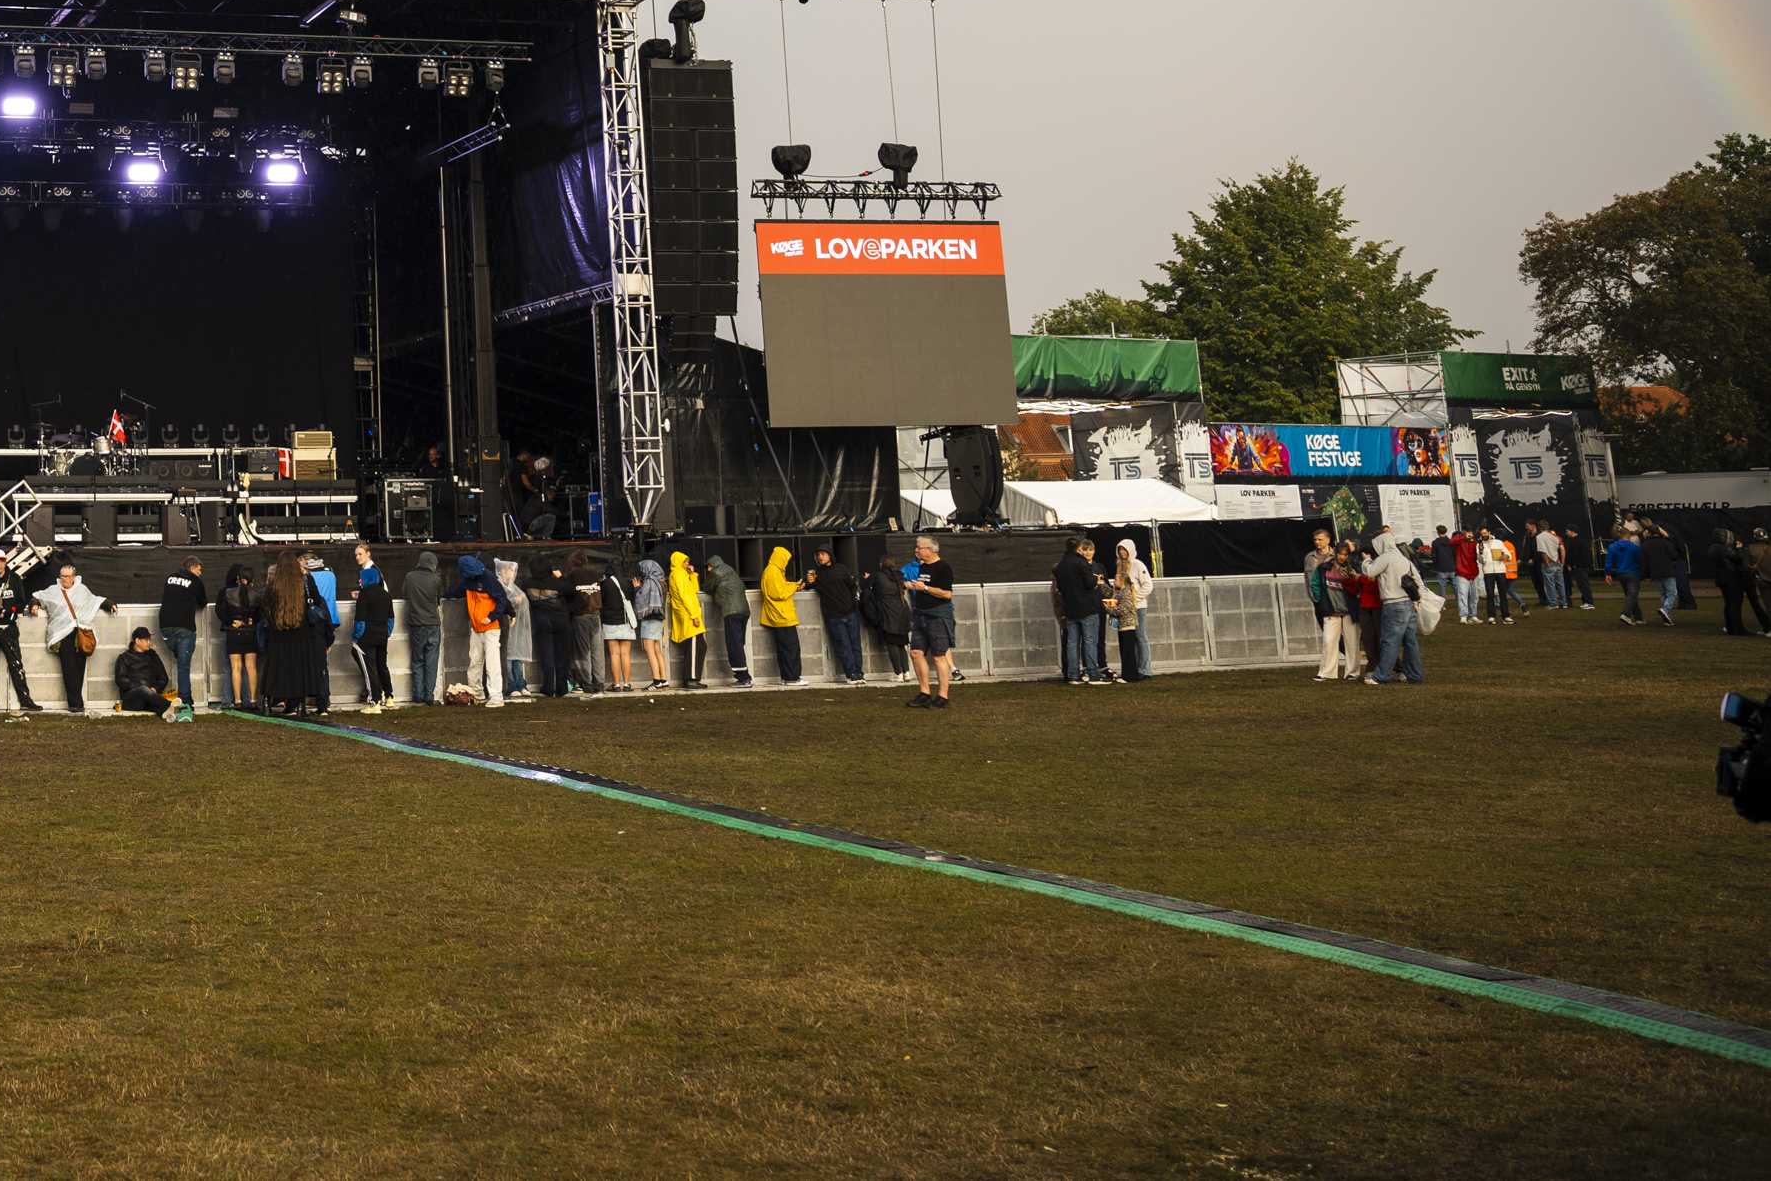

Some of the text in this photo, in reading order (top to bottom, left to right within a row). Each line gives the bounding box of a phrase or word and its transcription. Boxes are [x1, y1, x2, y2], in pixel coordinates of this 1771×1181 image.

[770, 239, 804, 254] KØGE
[1502, 367, 1528, 381] EXIT
[1505, 382, 1541, 391] PÅ GENSYN
[1305, 434, 1341, 450] KØGE
[1184, 453, 1211, 478] TS
[1308, 451, 1362, 467] FESTUGE
[1454, 454, 1479, 477] TS
[1584, 454, 1607, 477] TS
[1109, 456, 1142, 480] TS
[1509, 456, 1543, 479] TS
[1410, 489, 1431, 497] PARKEN
[167, 576, 192, 588] CREW
